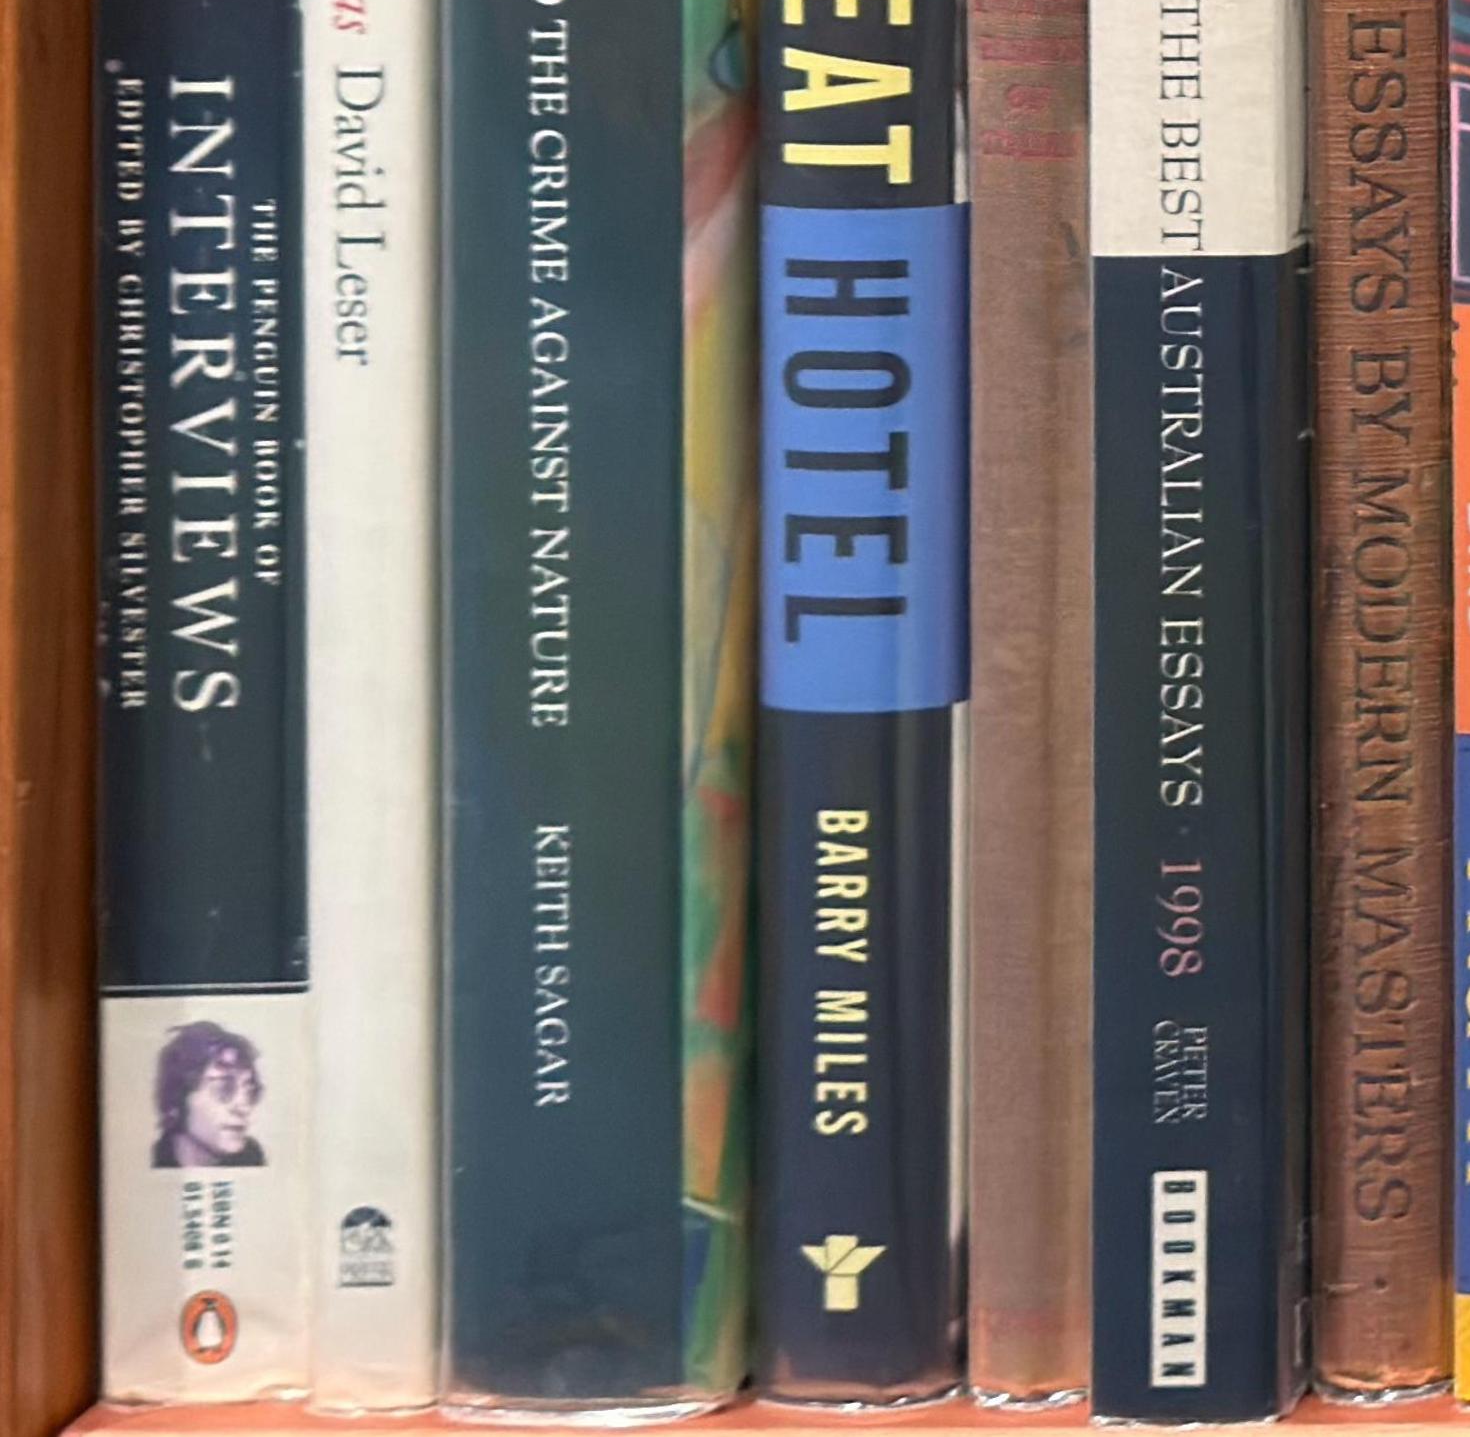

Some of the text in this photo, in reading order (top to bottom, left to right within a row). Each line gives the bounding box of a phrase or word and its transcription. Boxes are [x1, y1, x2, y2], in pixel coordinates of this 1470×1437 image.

[529, 19, 569, 116] THE
[333, 63, 387, 366] David Leser
[529, 128, 569, 284] CRIME
[1158, 118, 1203, 252] BEST
[116, 77, 147, 709] EDITED BY CHRISTOPHER SILVESTER
[168, 74, 239, 713] INTERVIEWS
[250, 199, 280, 586] THE PENGUIN BOOK OF
[529, 296, 569, 512] AGAINST
[781, 258, 911, 644] HOTEL
[1157, 266, 1205, 596] AUSTRALIAN
[529, 527, 570, 728] NATURE
[1158, 617, 1204, 808] ESSAYS
[1346, 13, 1416, 1221] ESSAYS BY MODERN MASTERS
[533, 823, 571, 1108] KEITH SAGAR
[814, 810, 869, 1136] BARRY MILES
[1155, 858, 1204, 978] 1998
[1151, 1018, 1182, 1125] CRAVEN
[1179, 1024, 1209, 1121] PETER
[1160, 1181, 1196, 1381] BOOKMAN
